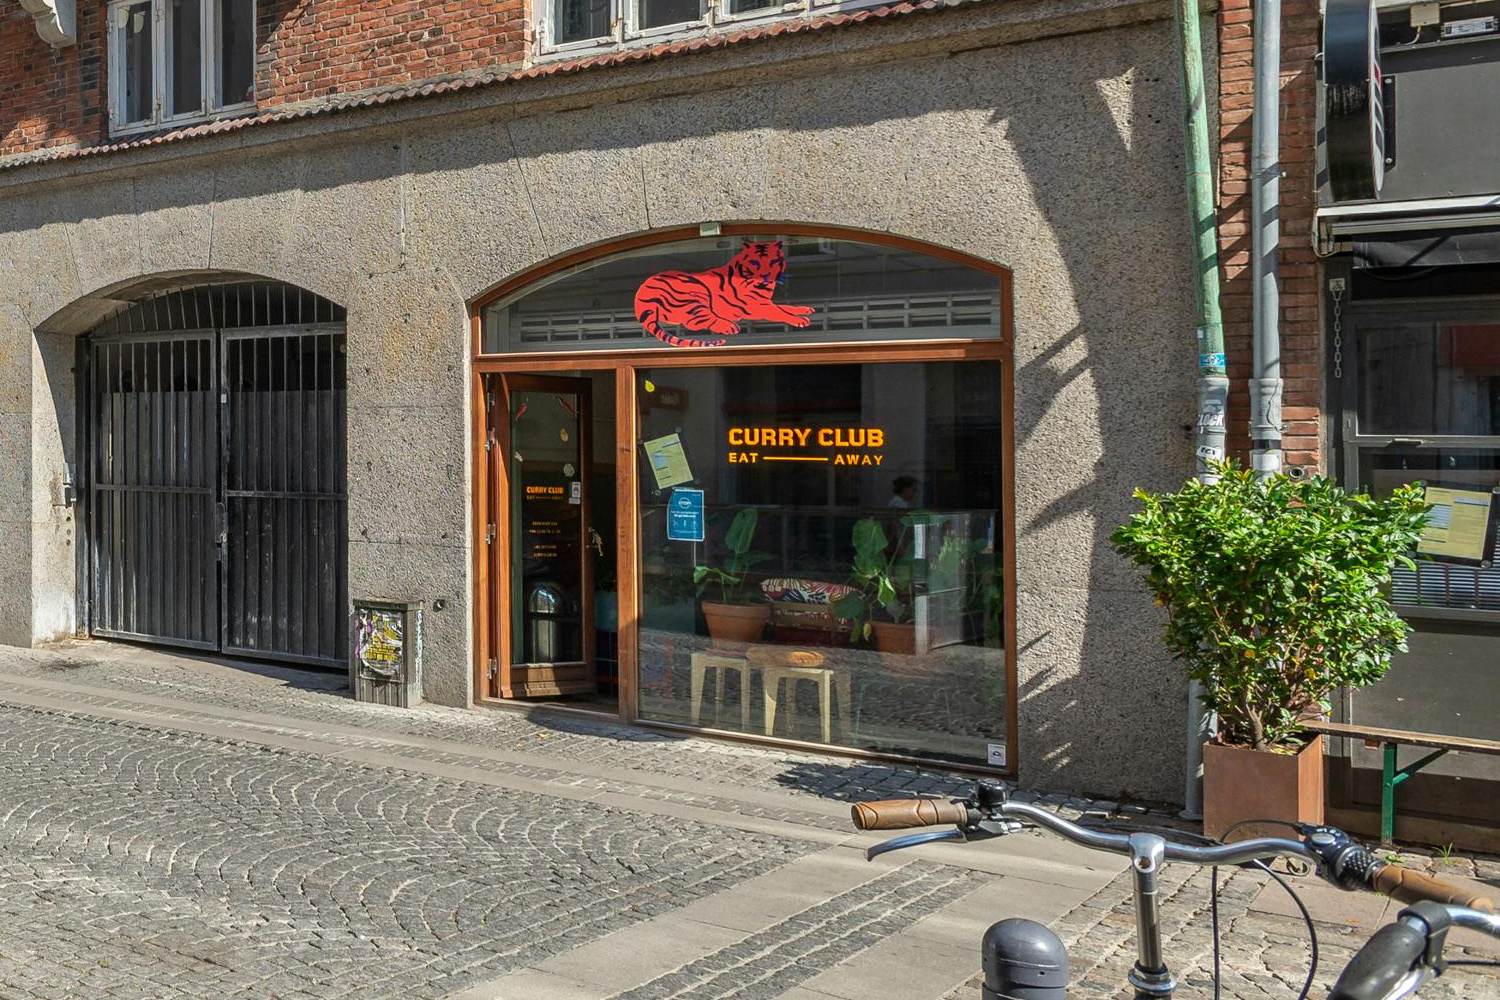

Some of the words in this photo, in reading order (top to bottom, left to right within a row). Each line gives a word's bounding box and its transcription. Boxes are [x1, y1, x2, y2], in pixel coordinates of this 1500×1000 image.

[728, 428, 812, 447] CURRY
[818, 428, 884, 447] CLUB
[728, 453, 759, 463] EAT
[834, 454, 883, 465] AWAY
